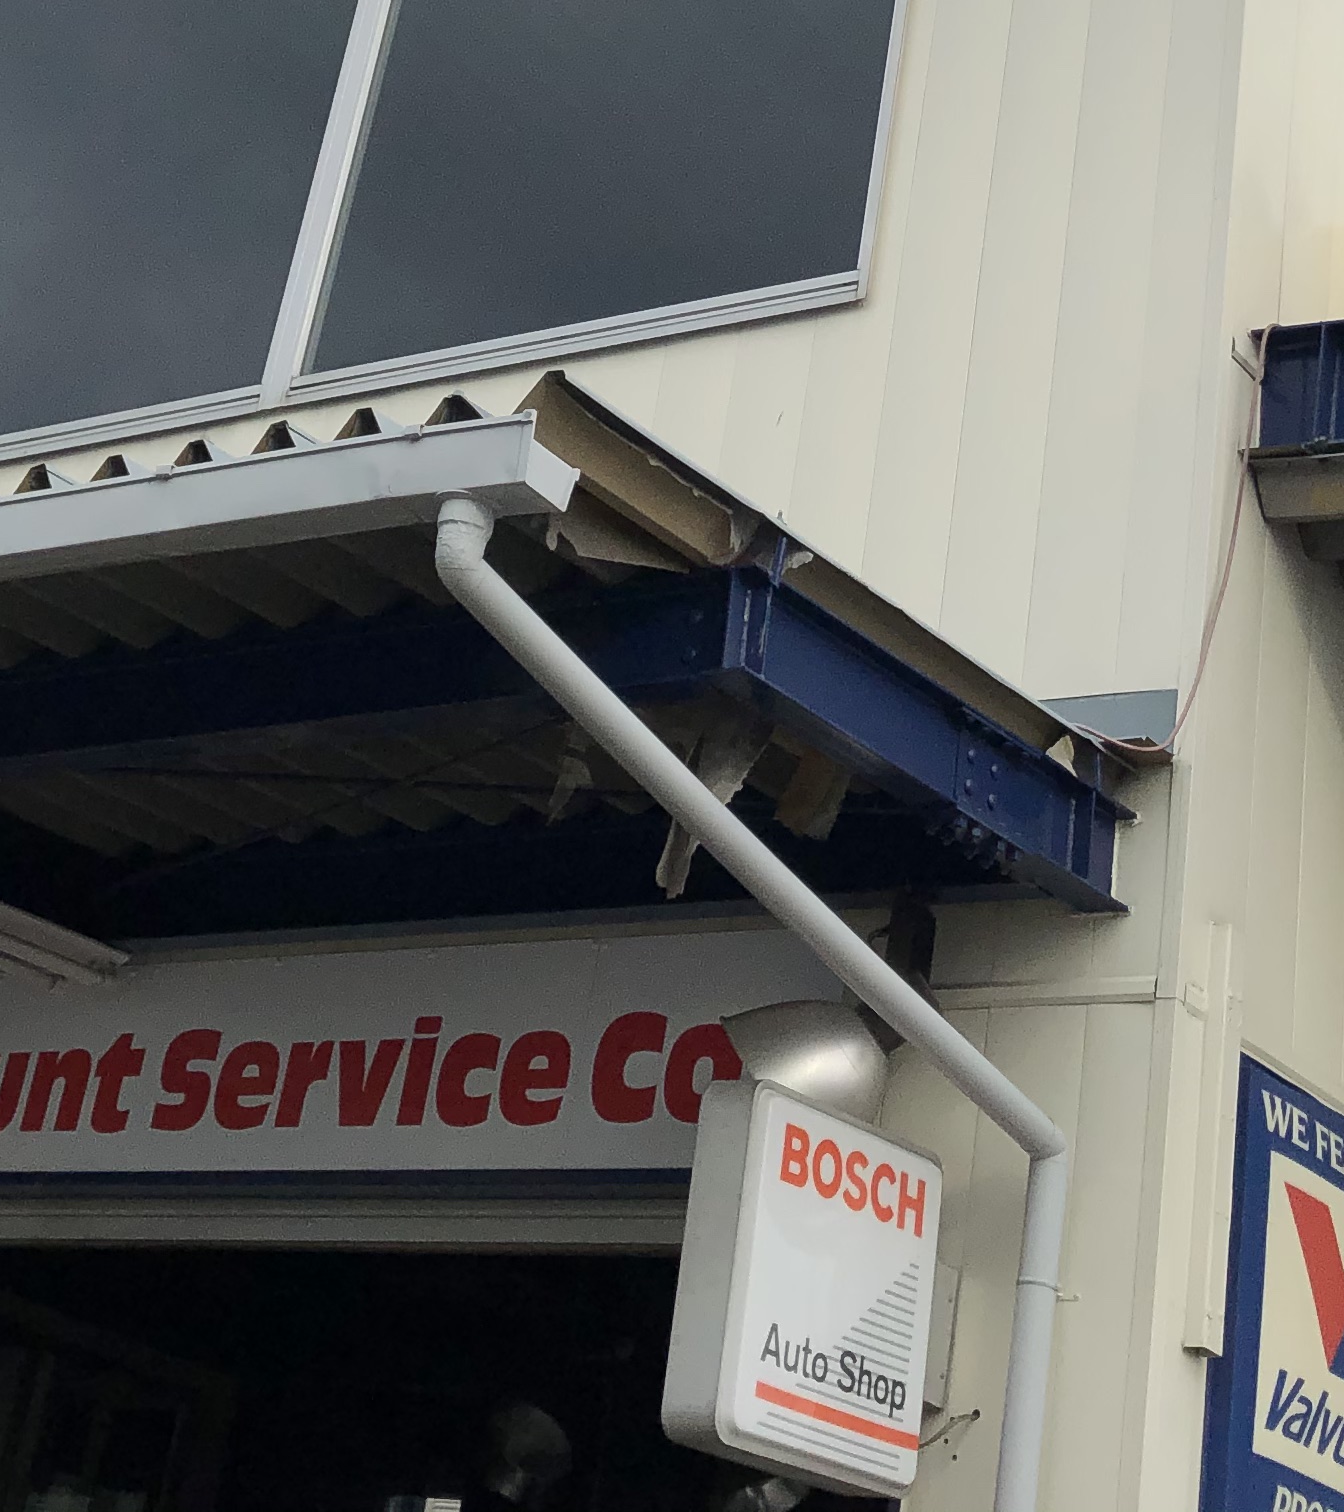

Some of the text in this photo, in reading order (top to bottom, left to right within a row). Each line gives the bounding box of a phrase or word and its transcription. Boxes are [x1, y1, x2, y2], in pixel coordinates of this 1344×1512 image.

[150, 1016, 571, 1131] Service
[1261, 1089, 1309, 1151] WE
[780, 1122, 926, 1238] BOSCH
[760, 1322, 907, 1417] Auto Shop
